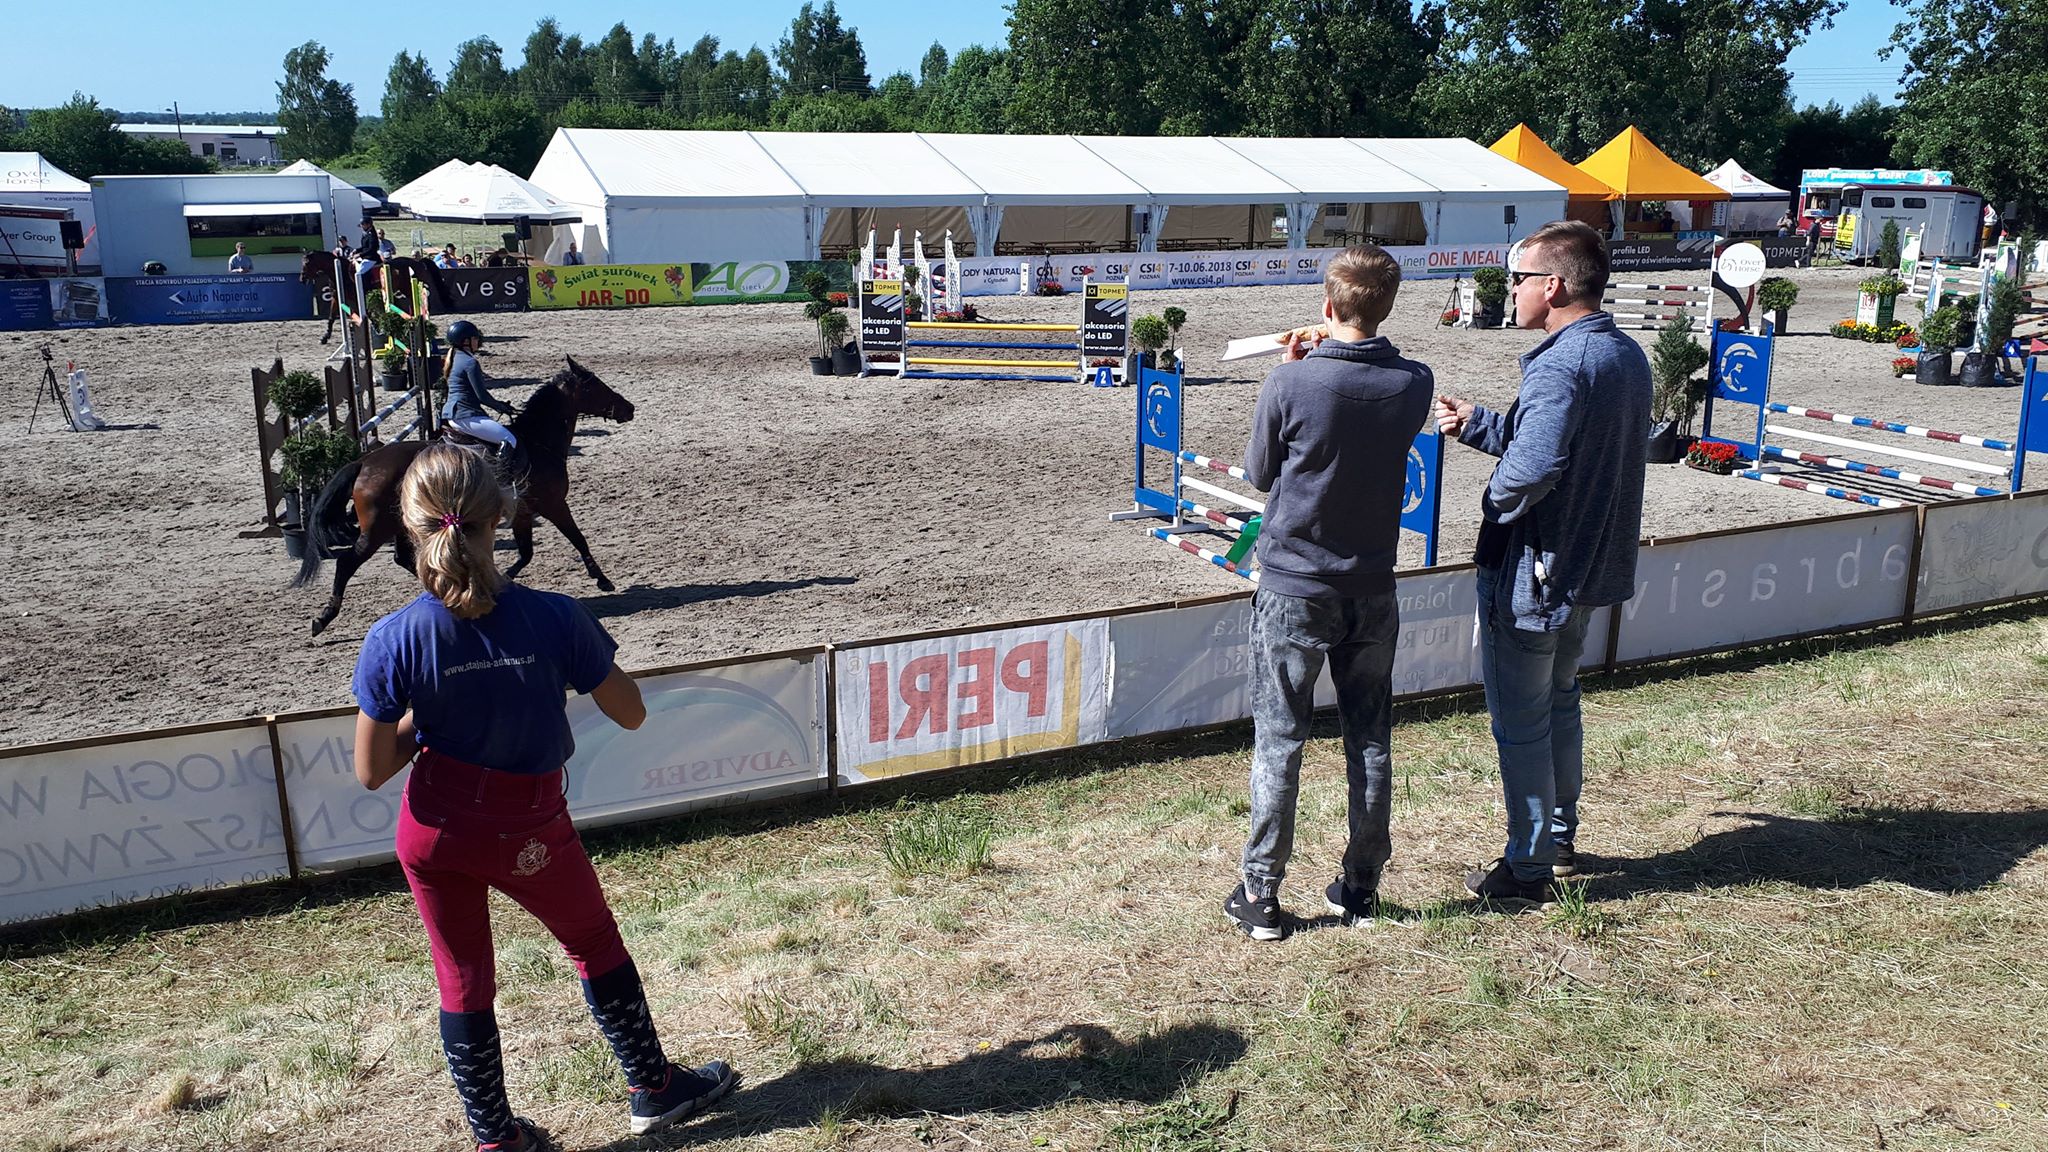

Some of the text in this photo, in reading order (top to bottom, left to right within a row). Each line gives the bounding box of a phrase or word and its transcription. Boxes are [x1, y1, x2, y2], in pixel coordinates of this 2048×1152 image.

[22, 230, 56, 244] Group
[1685, 231, 1712, 240] KASA
[1612, 245, 1650, 256] profile LED
[1765, 246, 1807, 258] TOPMET
[1428, 251, 1458, 267] ONE
[1462, 249, 1501, 265] MEAL
[1611, 256, 1692, 267] oprawy oświetleniowe
[1168, 261, 1232, 273] 7-10.06.2018
[1734, 264, 1761, 272] Horse
[563, 266, 659, 289] Świat surówek
[1171, 274, 1225, 287] www.csi4.pl
[186, 290, 209, 304] Auto
[862, 316, 902, 325] akcesoria
[1085, 321, 1125, 330] akcesoria
[863, 326, 890, 335] do LED
[1085, 332, 1113, 340] do LED
[1100, 370, 1107, 385] 2
